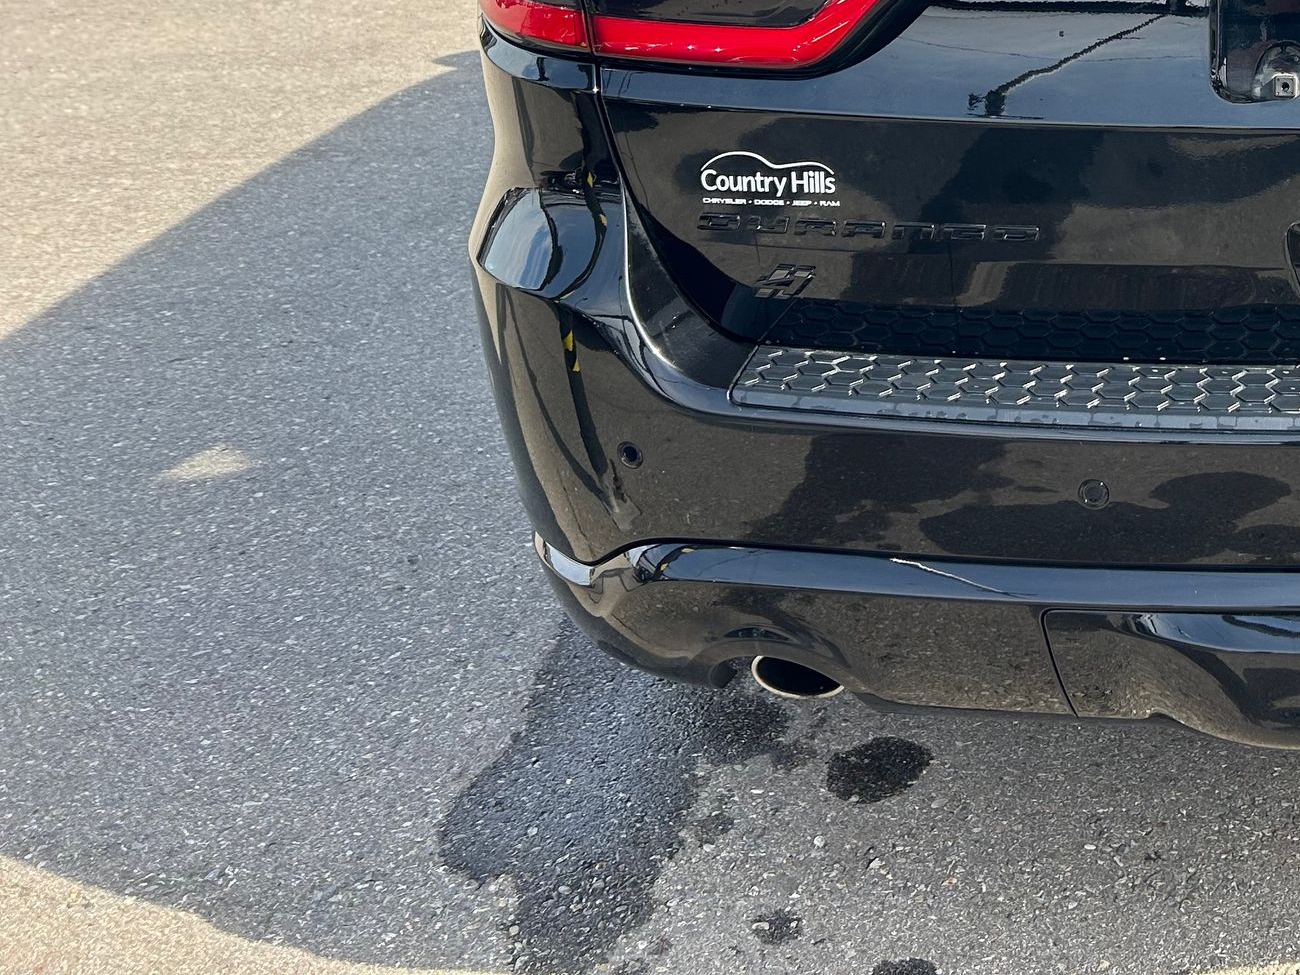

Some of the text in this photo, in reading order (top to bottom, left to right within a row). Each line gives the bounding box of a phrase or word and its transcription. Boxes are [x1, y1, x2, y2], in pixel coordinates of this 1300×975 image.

[700, 169, 836, 197] Country Hills
[702, 197, 747, 205] CHRYSLER
[791, 199, 813, 207] JEEP
[697, 211, 1041, 242] DURANGO
